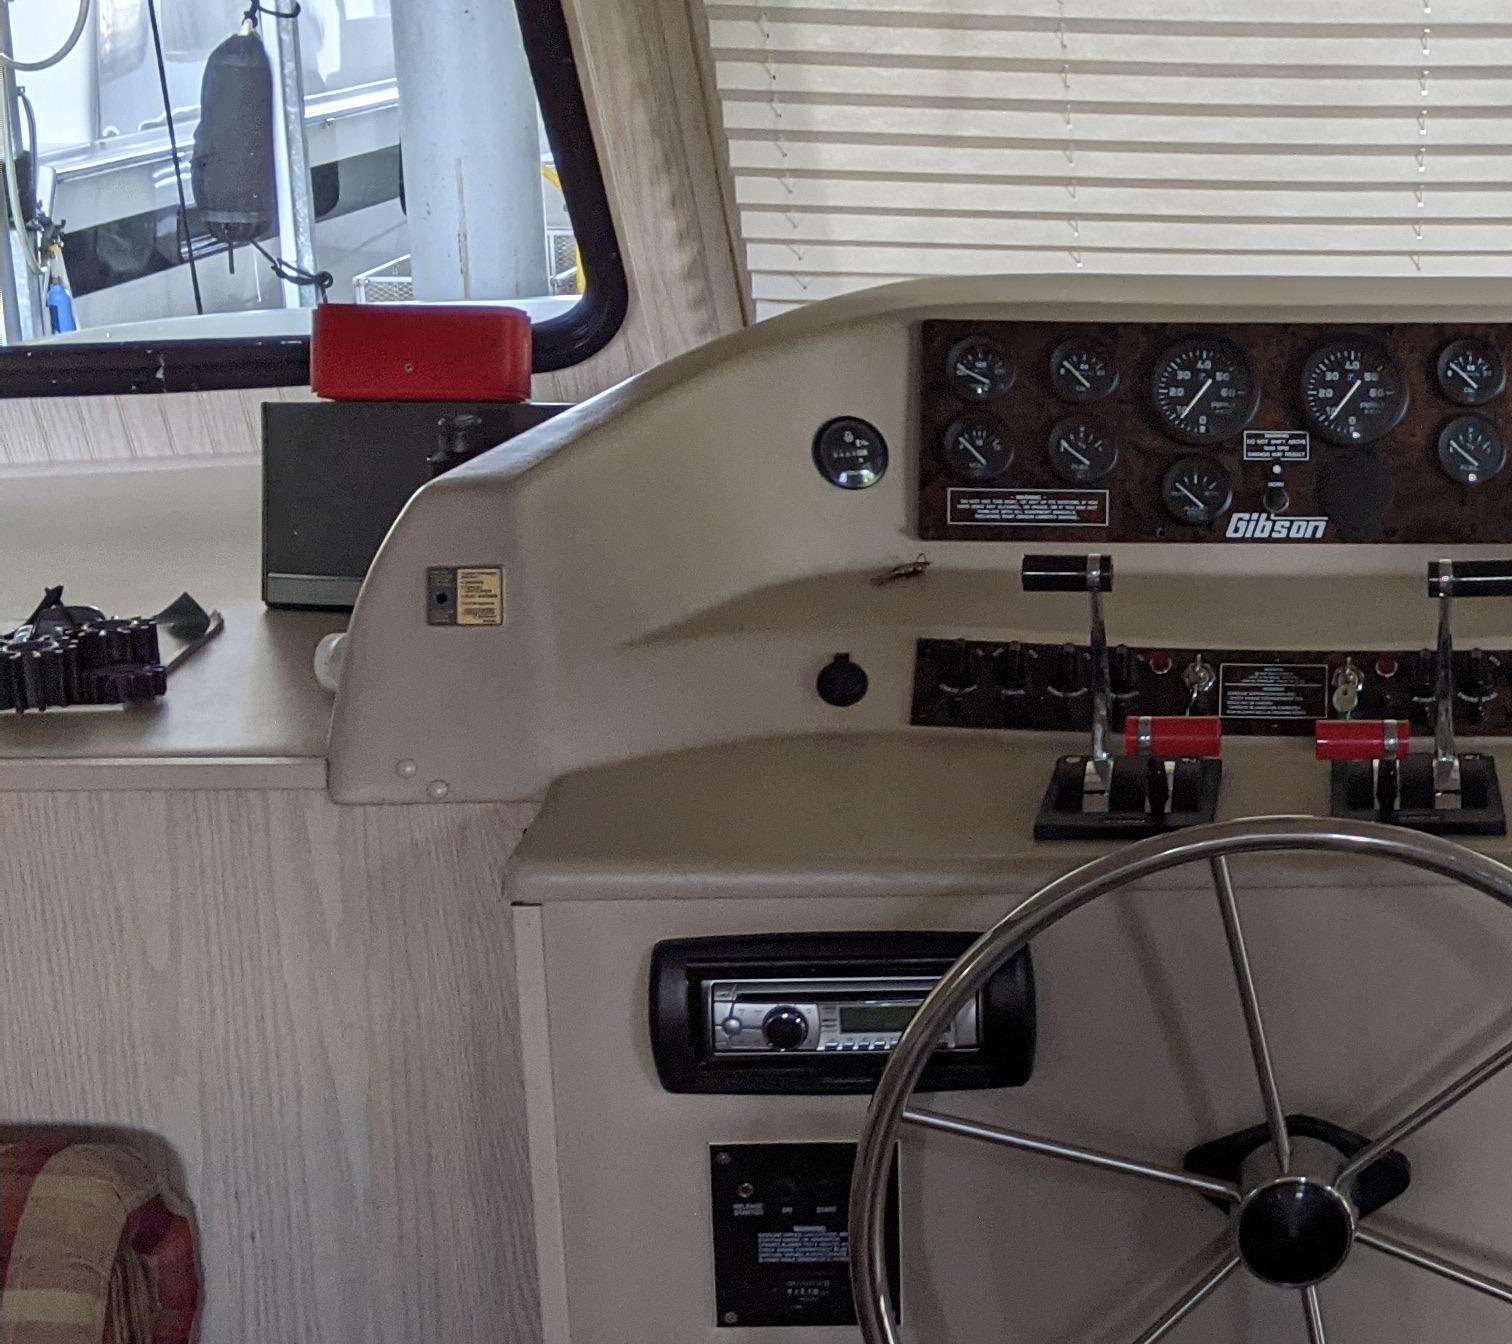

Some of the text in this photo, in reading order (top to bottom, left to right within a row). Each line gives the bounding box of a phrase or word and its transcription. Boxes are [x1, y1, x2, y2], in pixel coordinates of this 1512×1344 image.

[1197, 360, 1212, 369] 40
[1345, 361, 1359, 370] 40
[1177, 371, 1191, 380] 30
[1216, 372, 1230, 381] 50
[1325, 372, 1339, 381] 30
[1364, 372, 1379, 381] 50
[1169, 387, 1184, 397] 20
[1220, 388, 1235, 397] 60
[1318, 388, 1333, 398] 20
[1369, 388, 1384, 398] 60
[1199, 416, 1207, 425] 0
[1348, 416, 1356, 425] 0
[1225, 513, 1329, 539] Gibson
